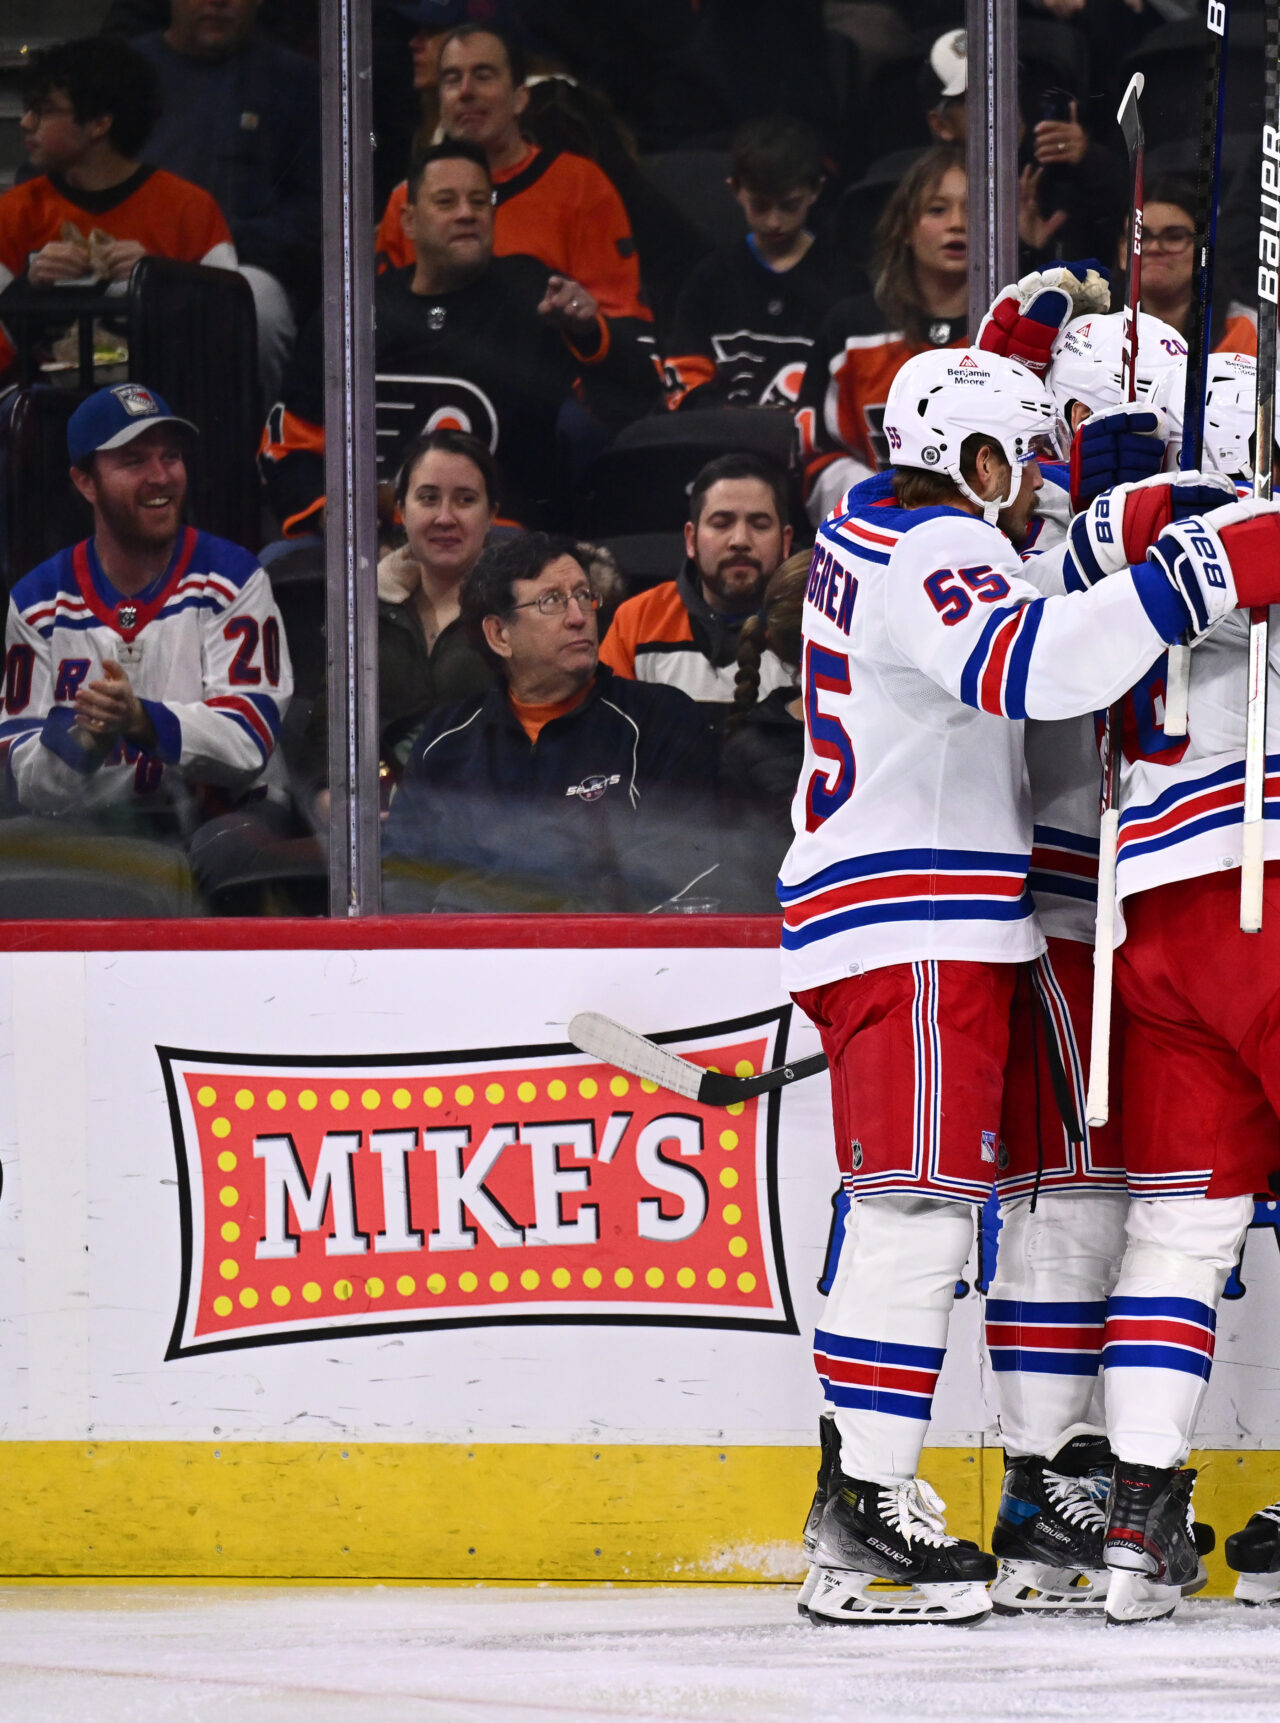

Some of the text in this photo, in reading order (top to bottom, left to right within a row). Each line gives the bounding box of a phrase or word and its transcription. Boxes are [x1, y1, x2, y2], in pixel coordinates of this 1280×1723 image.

[1133, 208, 1144, 256] CCM
[947, 367, 991, 379] Benjamin
[954, 376, 986, 387] Moore
[886, 427, 902, 450] 55
[923, 564, 1011, 627] 55
[223, 614, 281, 687] 20
[252, 1112, 709, 1260] MIKE'S
